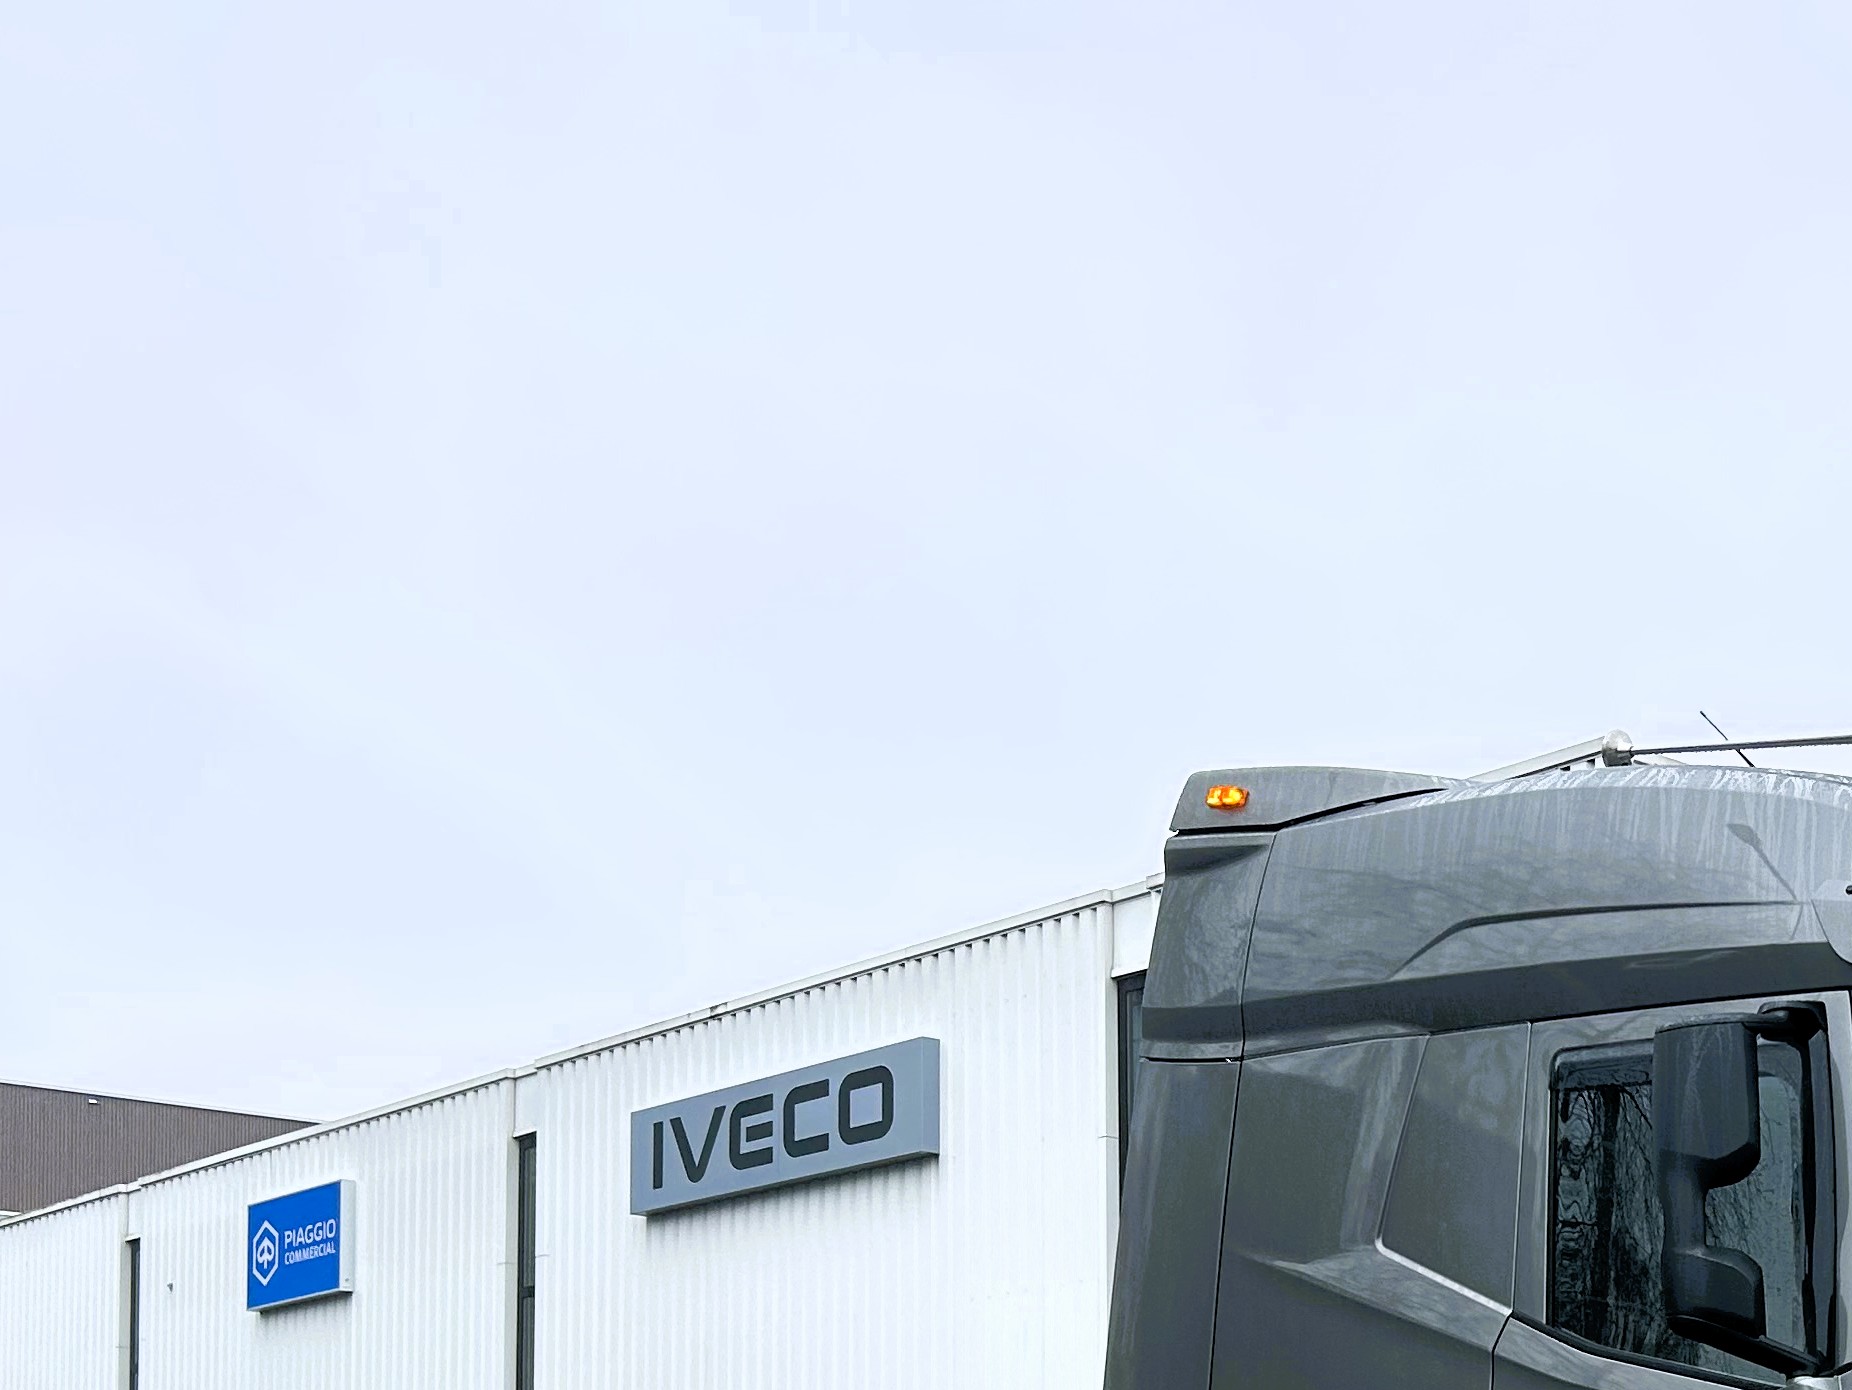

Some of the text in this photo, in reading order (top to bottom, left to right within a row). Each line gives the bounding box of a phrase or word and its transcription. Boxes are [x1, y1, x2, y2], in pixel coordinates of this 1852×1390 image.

[653, 1065, 894, 1190] IVECO
[284, 1219, 336, 1249] PIAGGIO
[284, 1241, 336, 1265] COMMERCIAL
